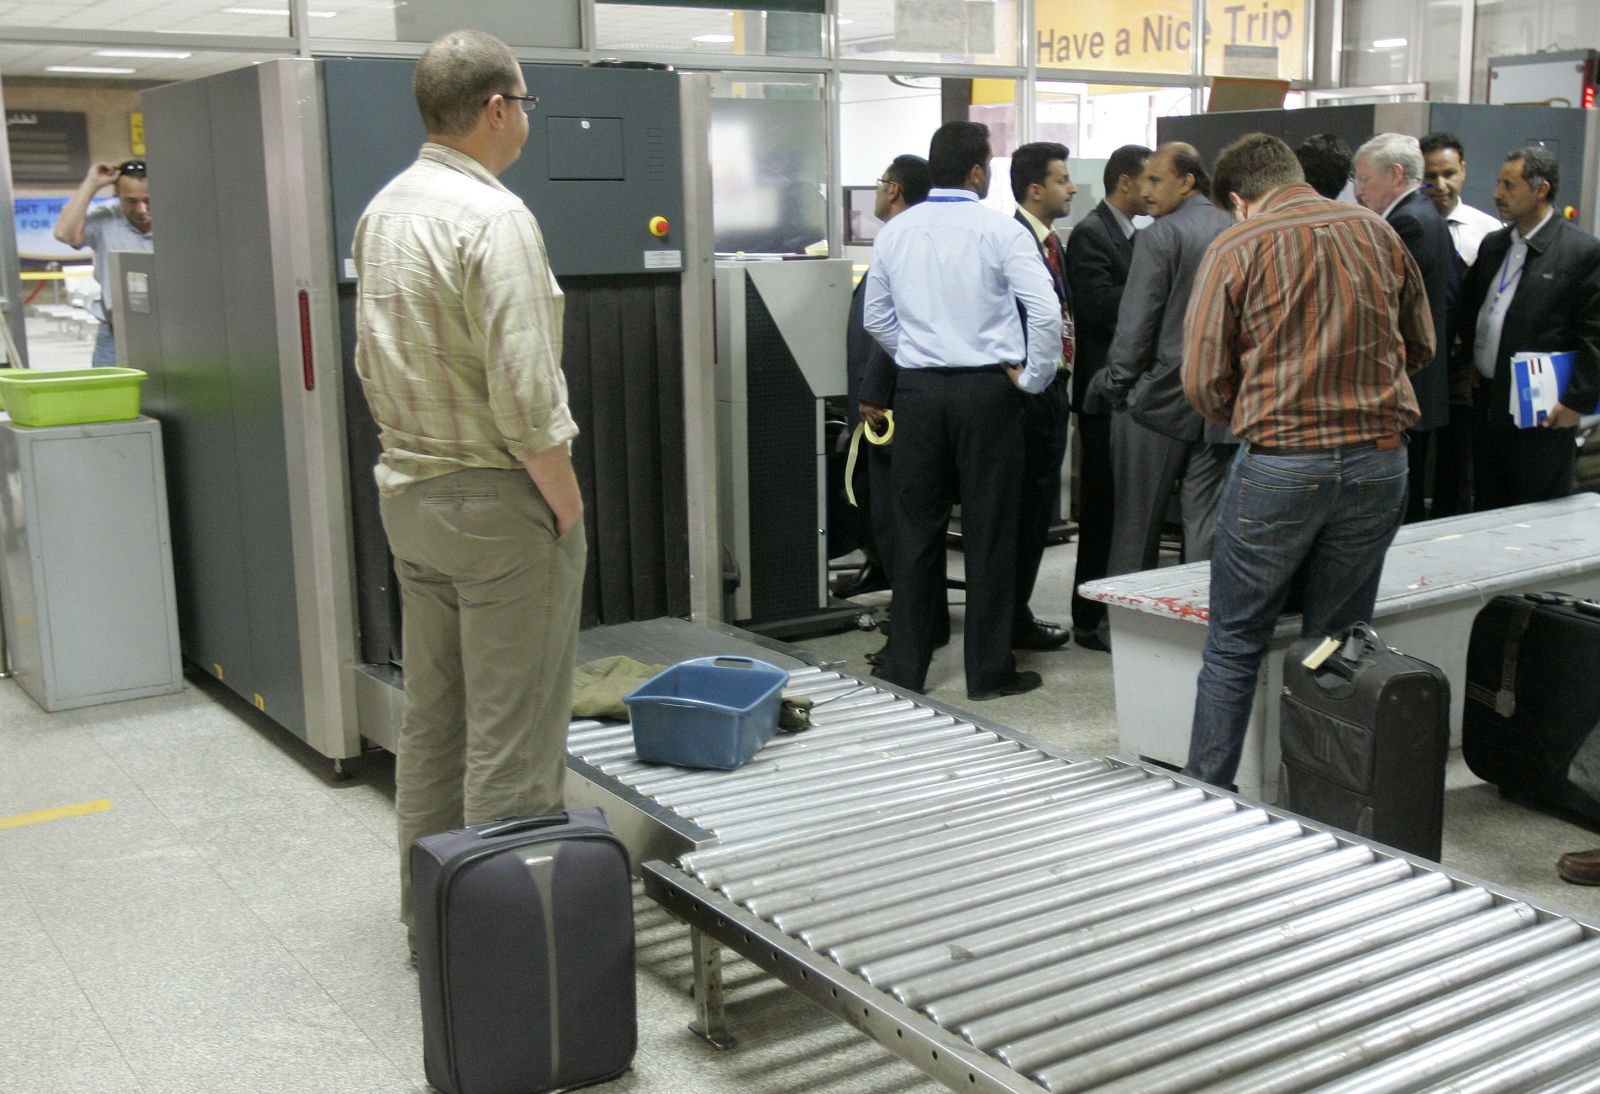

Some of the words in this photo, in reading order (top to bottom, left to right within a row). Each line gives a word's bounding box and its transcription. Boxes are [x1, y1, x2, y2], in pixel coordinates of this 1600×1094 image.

[1036, 28, 1105, 64] Have
[1115, 27, 1131, 56] a
[1223, 1, 1293, 48] Trip
[21, 219, 52, 230] FOR
